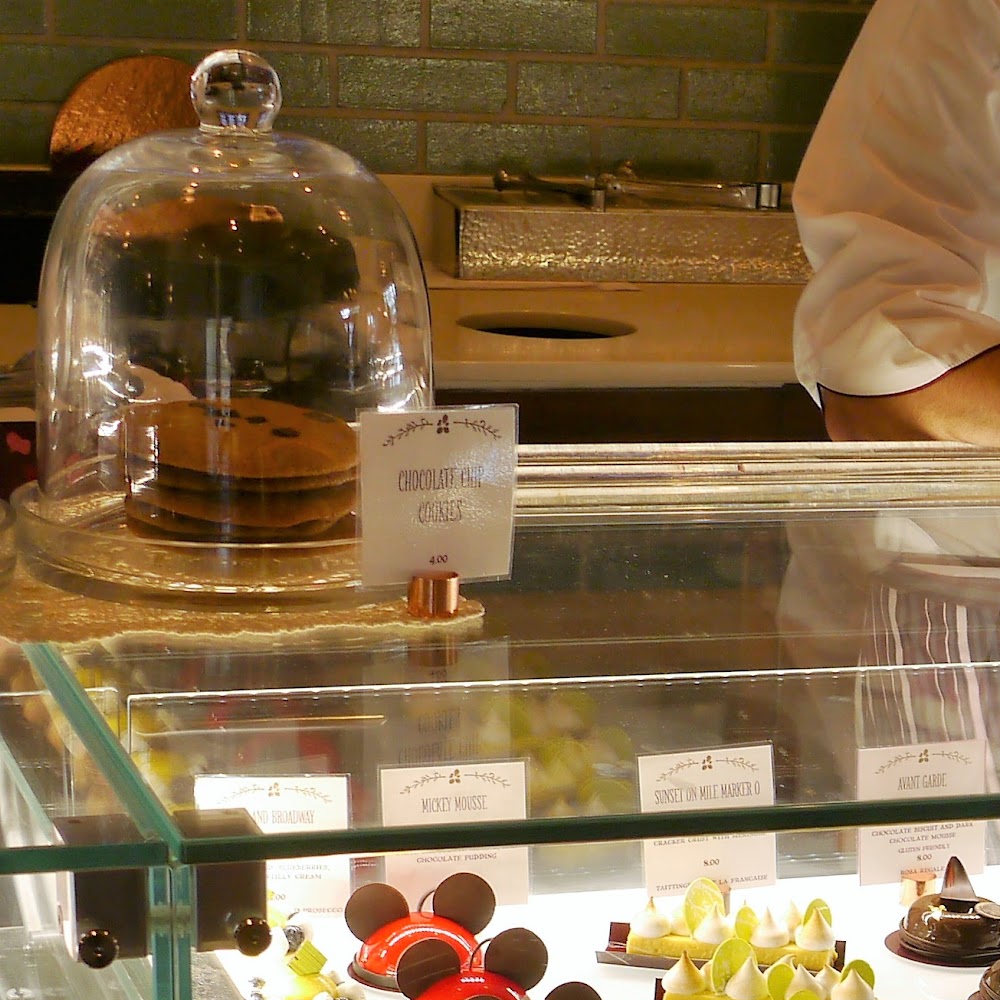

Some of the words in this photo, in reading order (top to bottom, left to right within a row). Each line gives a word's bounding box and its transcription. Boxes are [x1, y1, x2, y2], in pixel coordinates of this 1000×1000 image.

[398, 468, 456, 492] CHOCOLATE
[460, 466, 484, 489] CHIP
[418, 500, 463, 524] COOKIES
[429, 554, 448, 565] 4.00
[897, 775, 921, 791] AVANT
[922, 773, 947, 788] GARDE
[654, 788, 683, 805] SUNSET
[686, 786, 698, 802] ON
[699, 784, 719, 800] MILE
[720, 782, 752, 799] MARKER
[421, 796, 451, 813] MICKEY
[454, 795, 488, 812] MOUSSE
[272, 808, 315, 824] BROADWAY
[871, 827, 912, 837] CHOCOLATE
[653, 839, 686, 847] CRACKER
[889, 835, 930, 844] CHOCOLATE
[416, 855, 462, 864] CHOCOLATE
[464, 852, 497, 861] PUDDING
[703, 858, 720, 867] 8.00
[917, 853, 933, 861] 8.00
[655, 882, 691, 892] TAITTING
